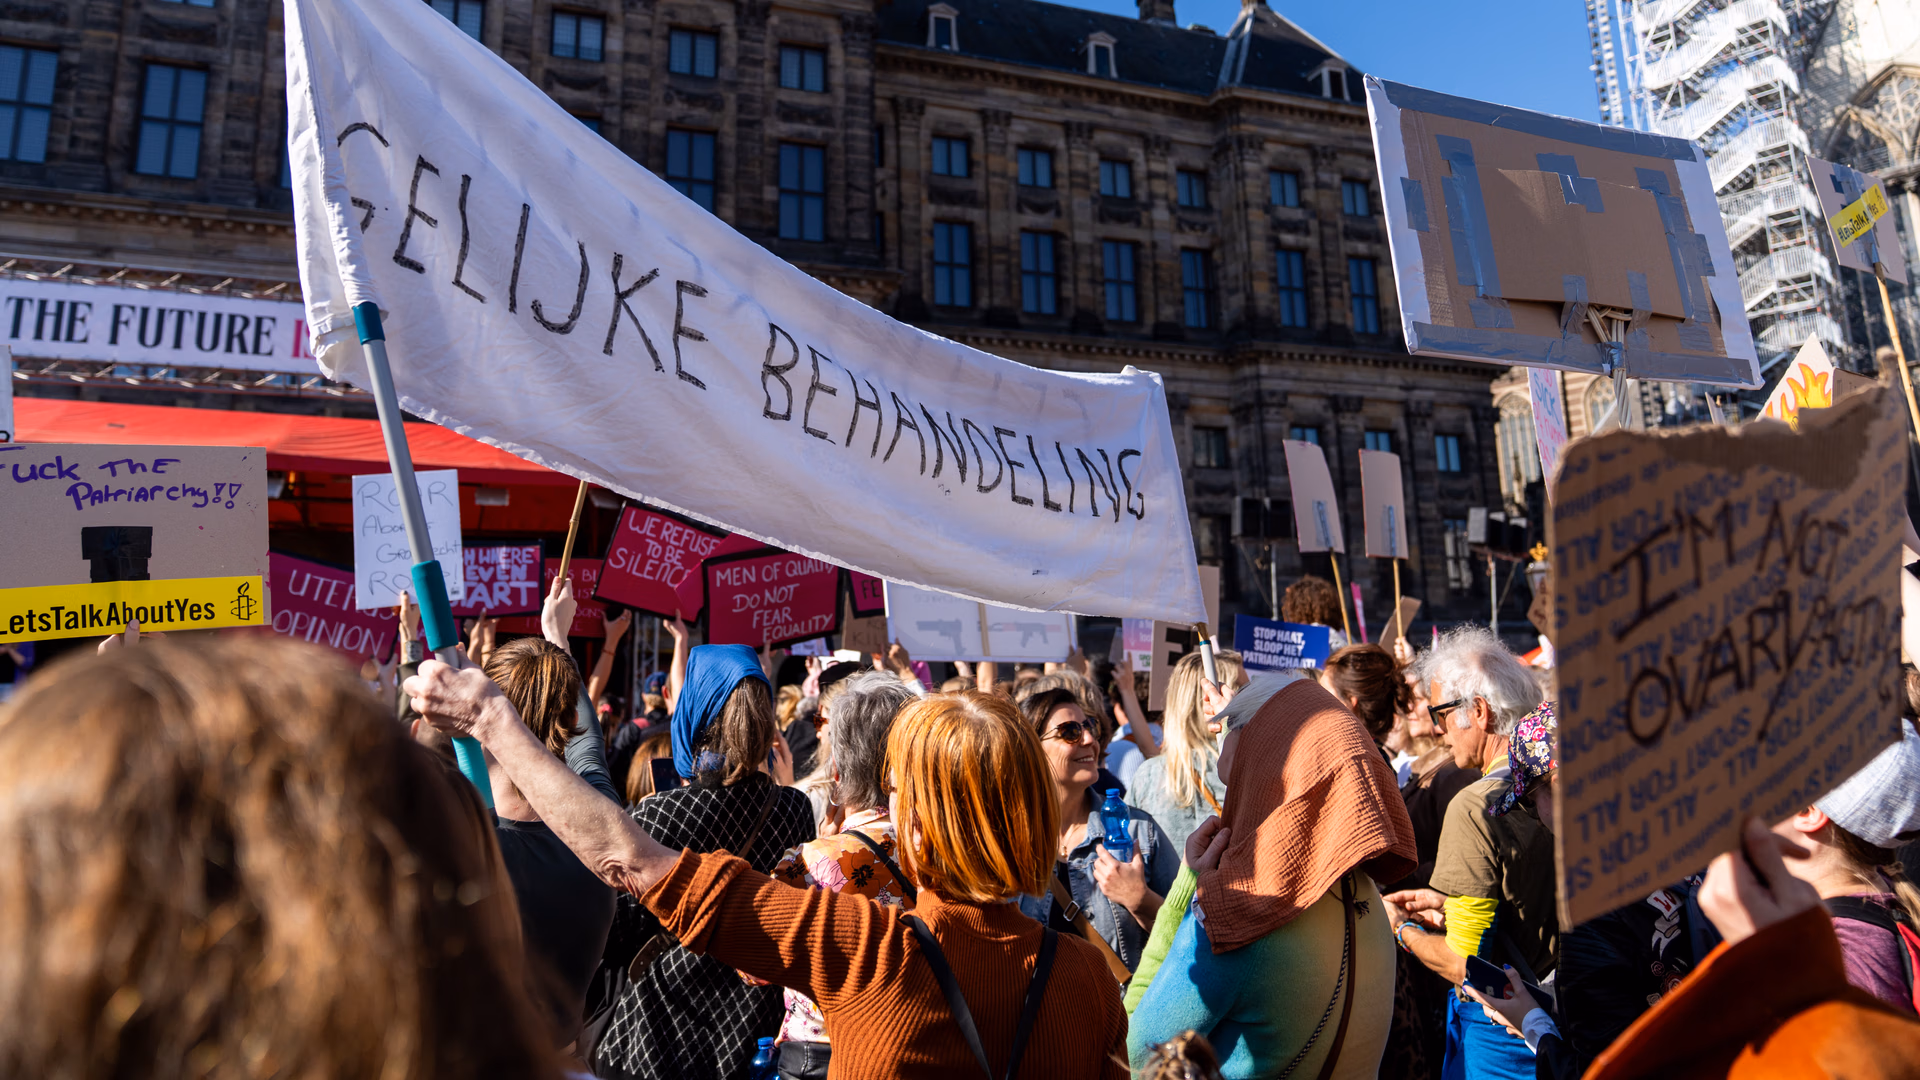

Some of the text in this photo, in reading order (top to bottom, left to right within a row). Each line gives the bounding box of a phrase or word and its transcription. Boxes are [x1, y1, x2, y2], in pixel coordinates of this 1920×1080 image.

[7, 296, 93, 344] THE
[108, 303, 277, 357] FUTURE
[760, 322, 1145, 523] BEHANDELING
[357, 480, 454, 514] ROR
[628, 510, 661, 537] WE
[645, 538, 685, 566] TO BE
[1756, 499, 1848, 582] NOT
[478, 547, 535, 566] WHERE
[465, 564, 527, 582] EVEN
[716, 565, 756, 588] MEN
[762, 562, 782, 582] OF
[450, 581, 538, 609] TART
[731, 583, 800, 613] DO NOT
[0, 598, 216, 635] etsTalkAboutYes
[752, 606, 793, 629] FEAR
[762, 613, 833, 643] EQUALITY
[271, 609, 385, 657] OPINION
[1253, 626, 1306, 646] STOP HAAT,
[1253, 639, 1304, 657] SLOOP HET
[1628, 757, 1677, 813] FOR
[1575, 792, 1622, 845] ALL
[1656, 786, 1699, 838] ALL
[1599, 819, 1651, 876] FOR
